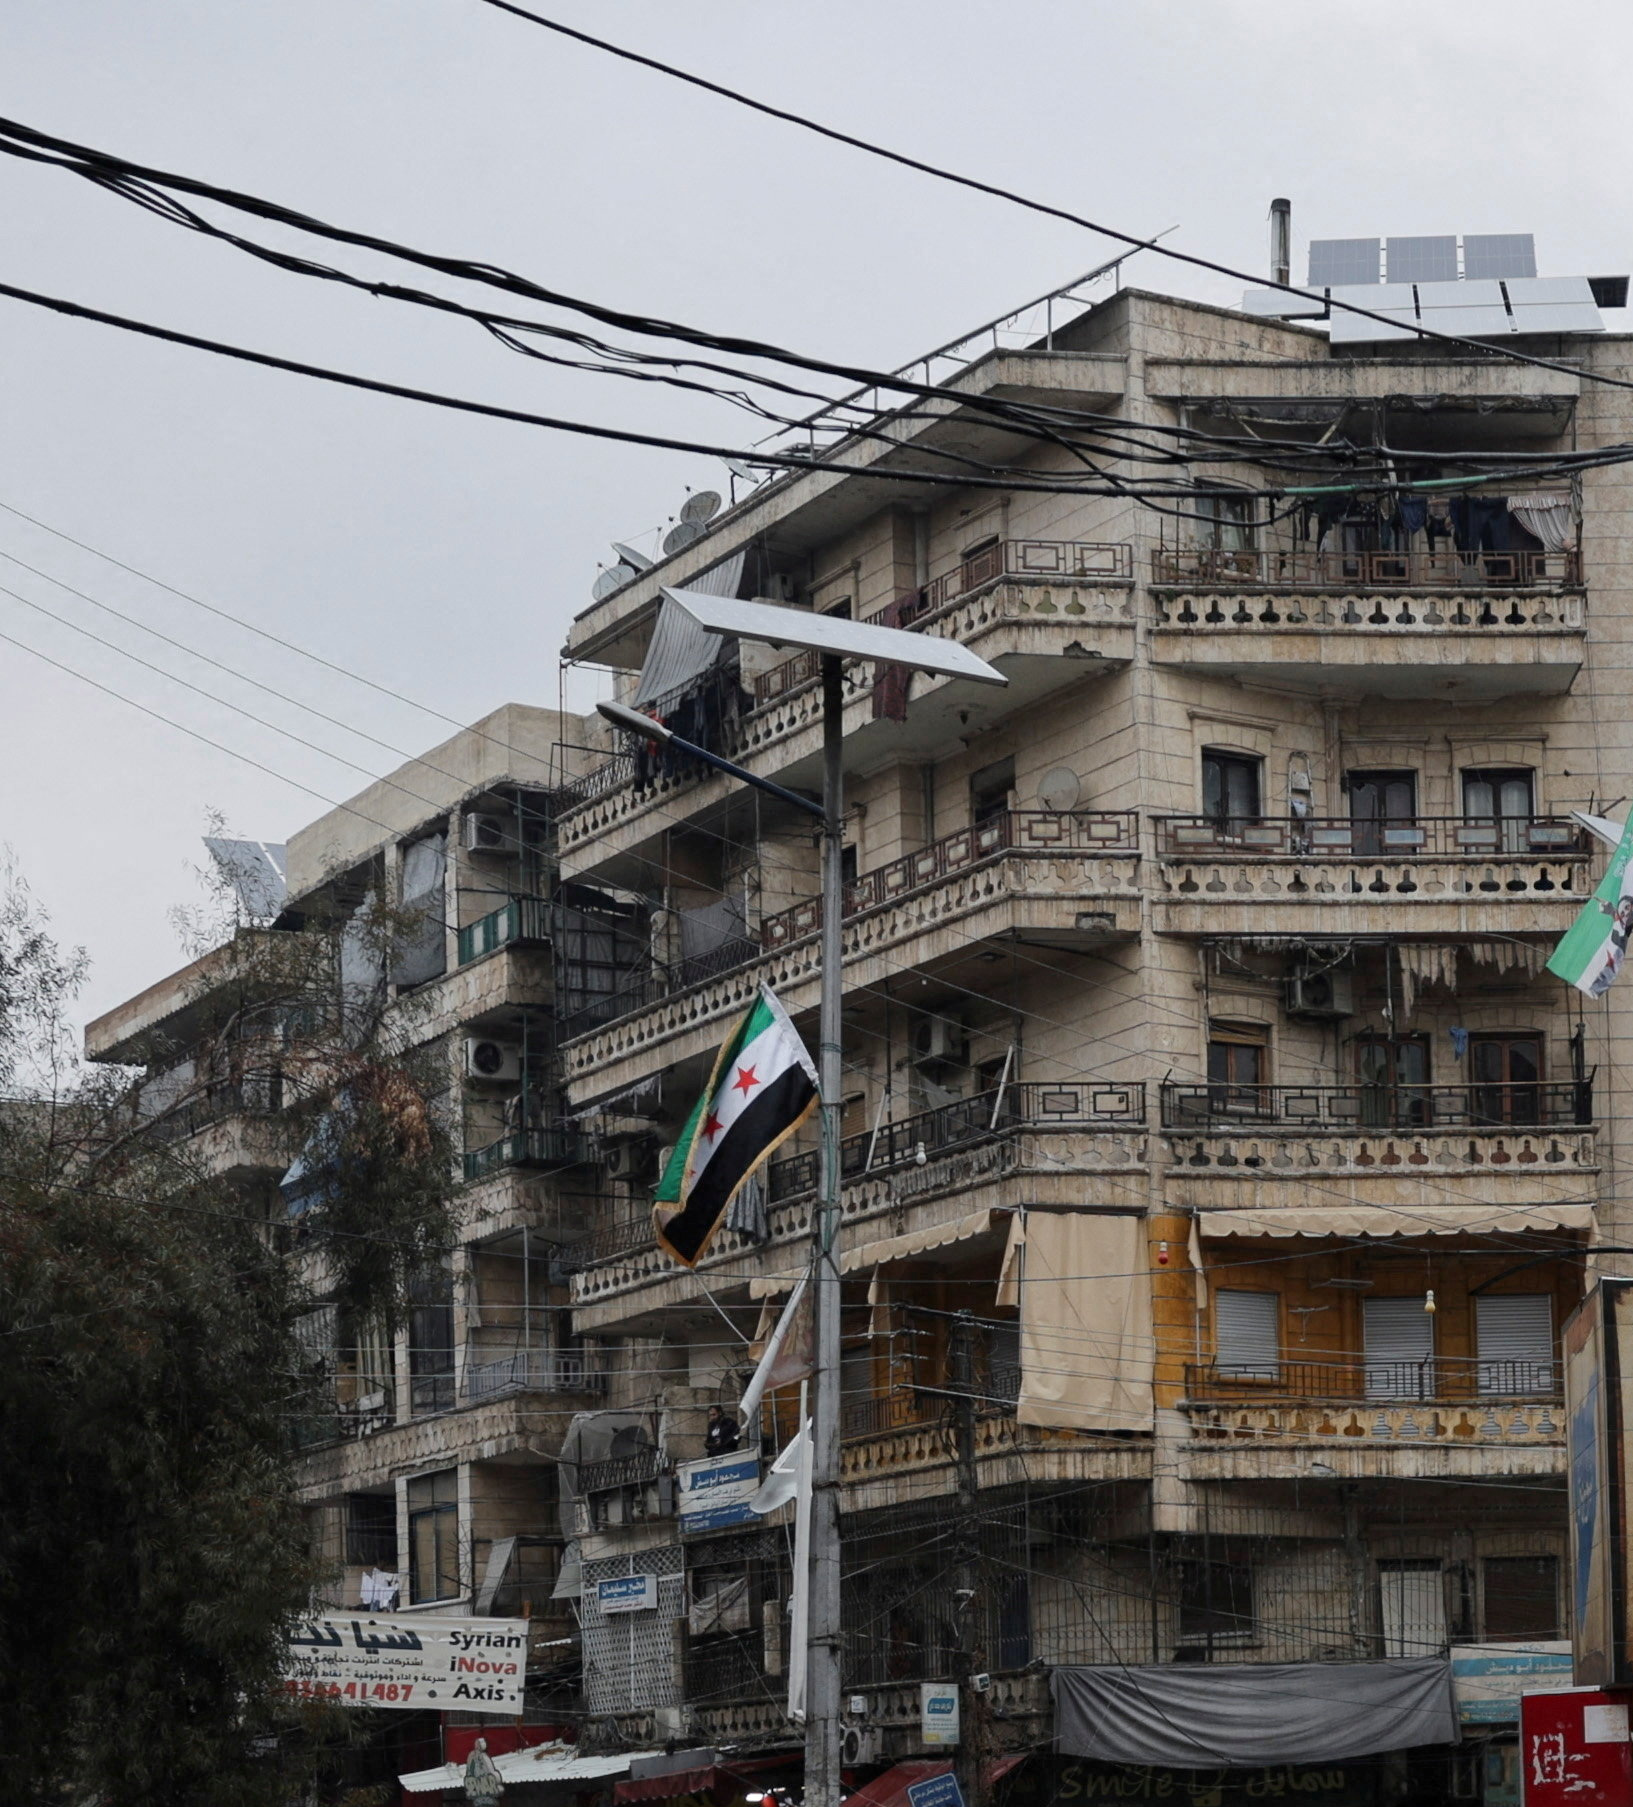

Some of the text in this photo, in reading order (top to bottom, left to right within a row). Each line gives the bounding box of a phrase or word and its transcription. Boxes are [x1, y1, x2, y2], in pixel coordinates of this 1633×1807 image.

[449, 1630, 522, 1651] Syrian
[450, 1655, 518, 1675] iNova
[453, 1683, 505, 1701] Axis
